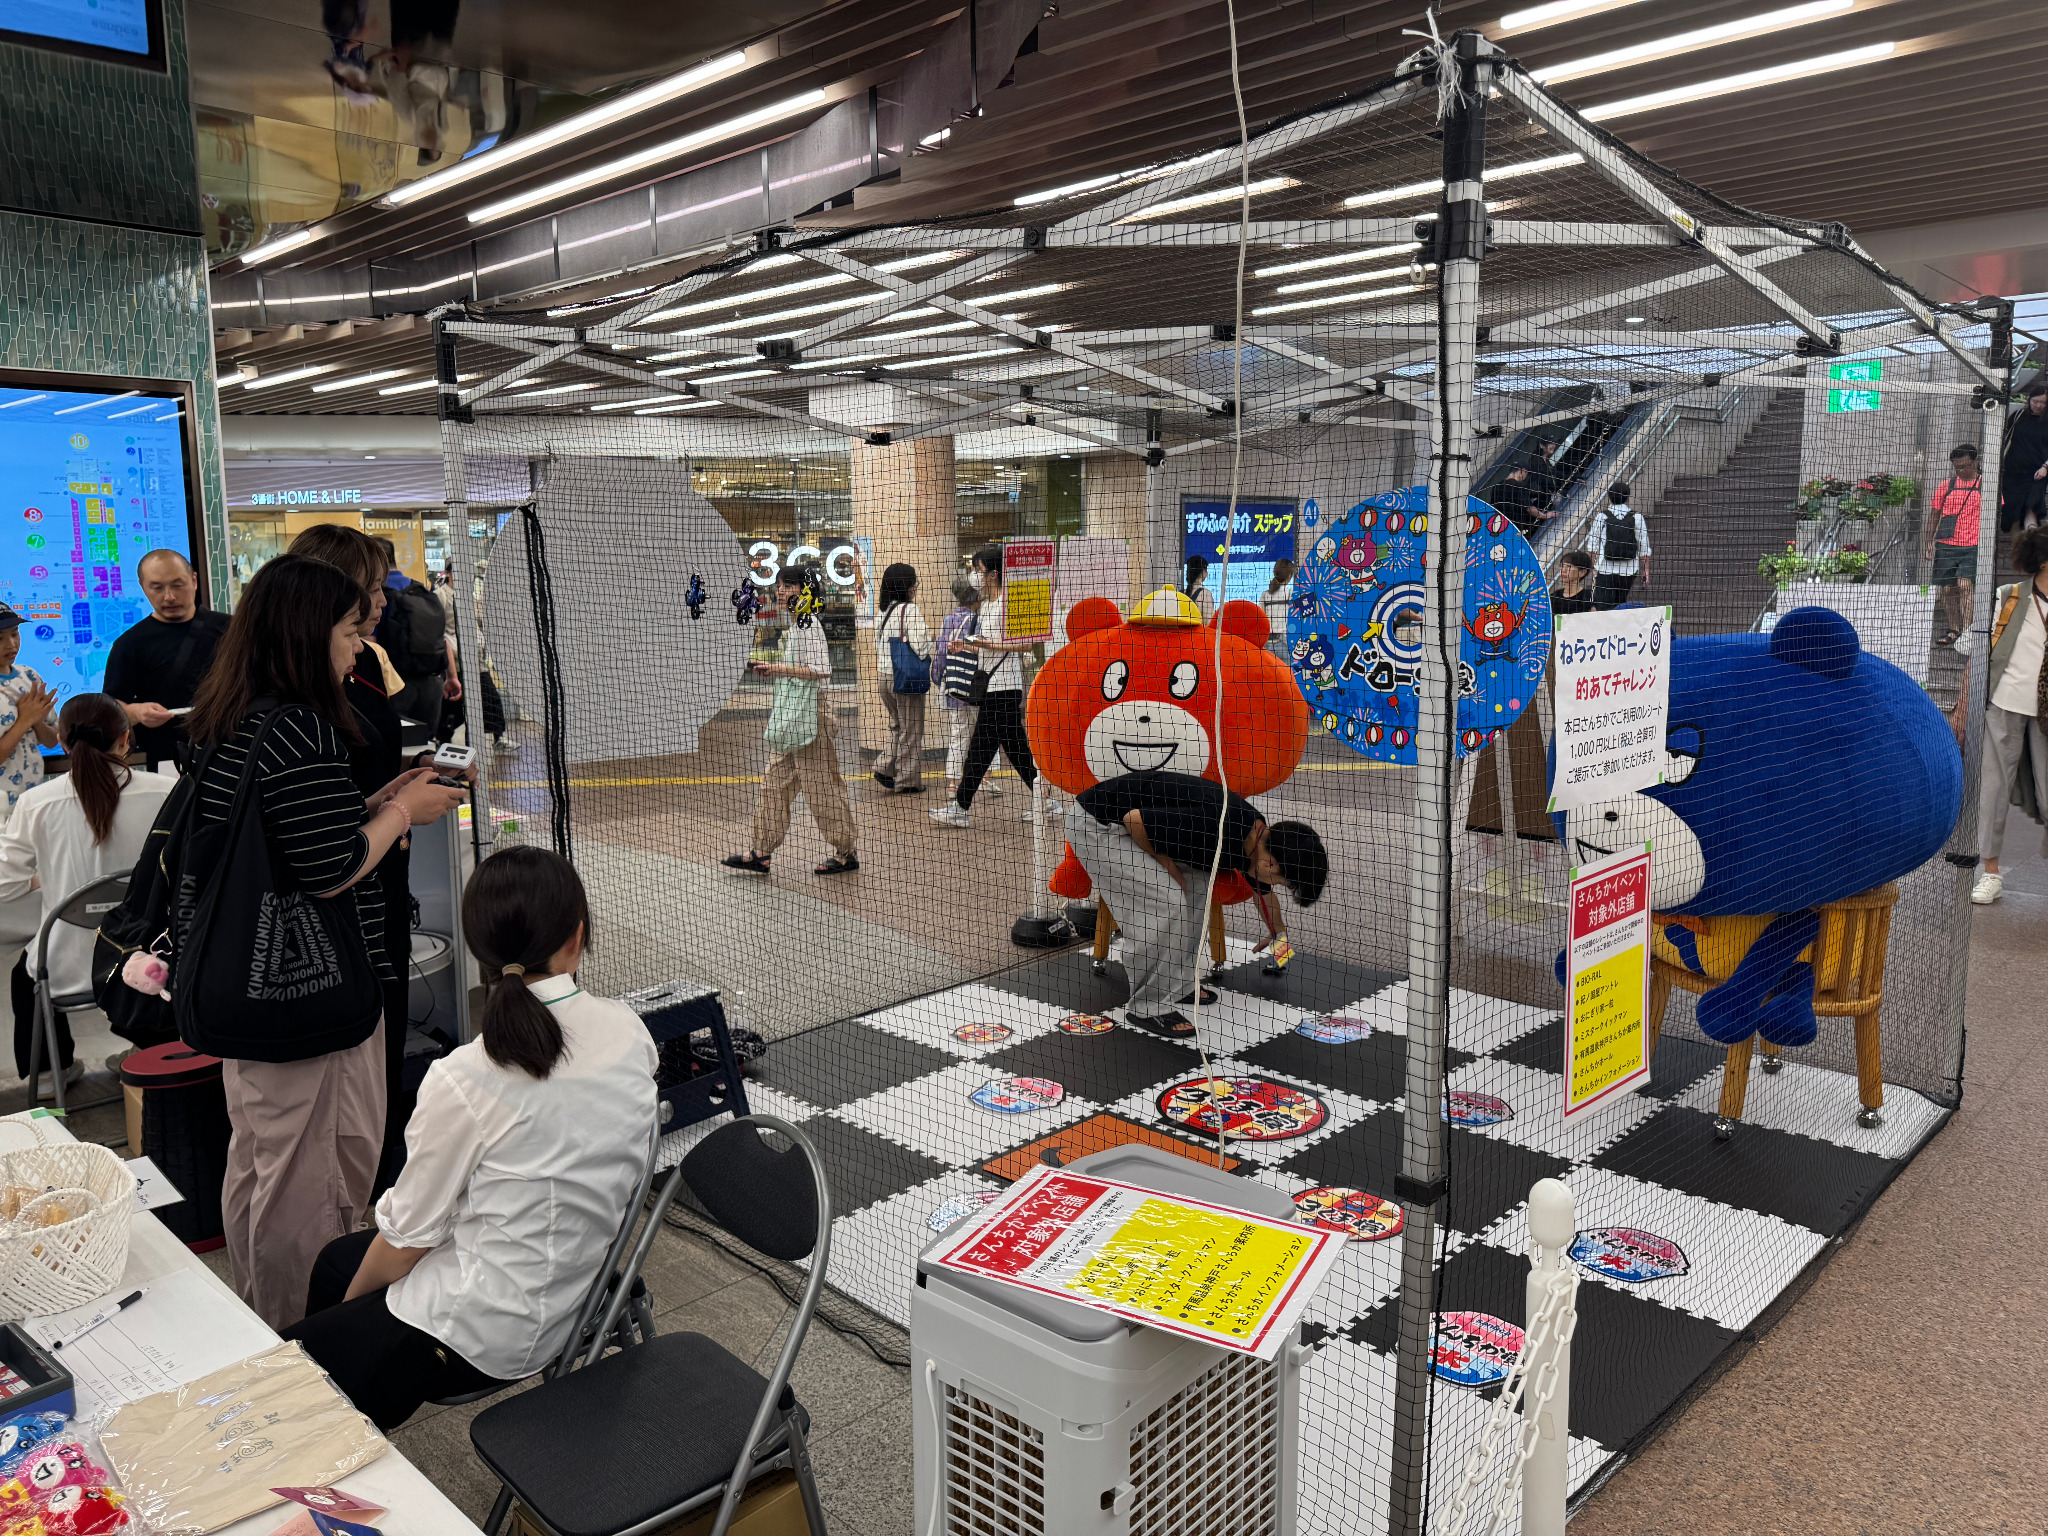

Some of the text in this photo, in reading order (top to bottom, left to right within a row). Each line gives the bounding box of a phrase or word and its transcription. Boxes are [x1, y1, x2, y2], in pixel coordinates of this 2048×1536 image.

[278, 490, 319, 504] HOME
[321, 490, 331, 504] &
[333, 489, 361, 503] LIFE
[1254, 513, 1293, 533] ステップ
[1560, 633, 1646, 665] ねらってドローン
[1340, 643, 1475, 695] ドロー
[1576, 665, 1656, 700] 的あてチャレンジ
[1565, 702, 1662, 735] 本日さんちかでご利用のレシート
[1567, 749, 1655, 784] ご提示でご参加いただけます。
[1578, 867, 1643, 908] さんちかイベント
[1588, 891, 1635, 928] 対象外店舗
[247, 904, 274, 1000] KINOKUNIYA
[297, 906, 324, 965] KINOKUNIYA
[1580, 969, 1602, 987] BIO-RAL
[1580, 1010, 1628, 1041] ミスタークイックマン
[1580, 1019, 1641, 1060] 有馬温泉神戸さんちか案内所
[1579, 1052, 1614, 1077] さんちかホール
[1579, 1055, 1641, 1096] さんちかインフォメーション
[1182, 1224, 1257, 1312] 有馬温泉神戸さんちか案内所
[1235, 1237, 1303, 1327] さんちかインフォメーション
[1209, 1270, 1253, 1320] さんちかホール
